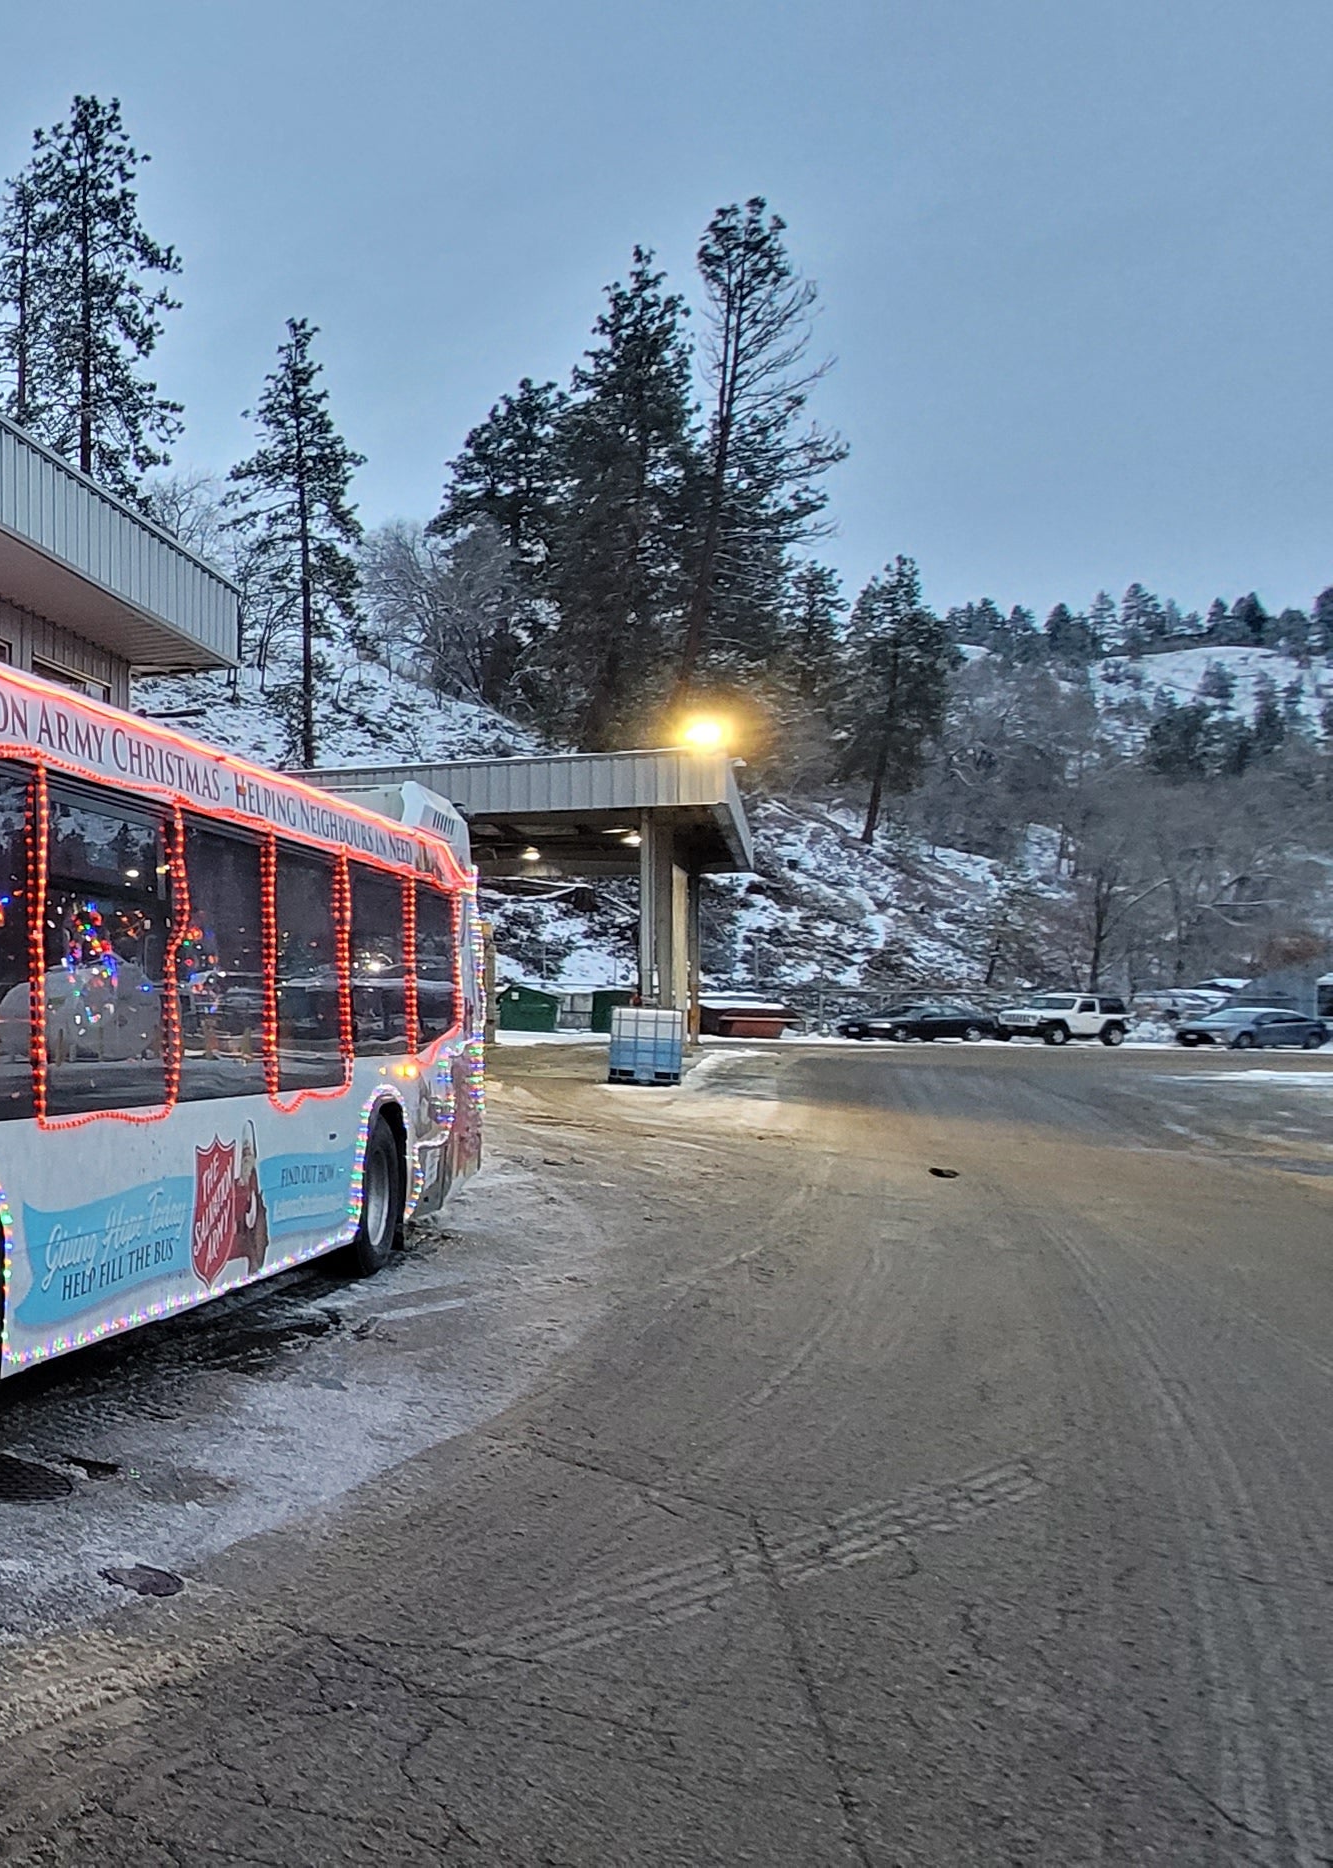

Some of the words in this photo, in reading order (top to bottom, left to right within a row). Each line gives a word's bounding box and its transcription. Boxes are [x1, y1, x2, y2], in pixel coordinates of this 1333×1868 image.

[36, 700, 107, 763] ARMY
[111, 728, 221, 803] CHRISTMAS
[233, 772, 296, 827] HELPING
[300, 797, 373, 850] NEIGHBOURS
[388, 832, 413, 864] NEED
[194, 1157, 233, 1257] SALVATION
[202, 1152, 220, 1203] THE
[281, 1166, 300, 1188] FIND
[301, 1165, 317, 1184] OUT
[62, 1266, 96, 1302] HELP
[99, 1255, 124, 1289] FILL
[128, 1244, 151, 1274] THE
[154, 1237, 175, 1265] BUS
